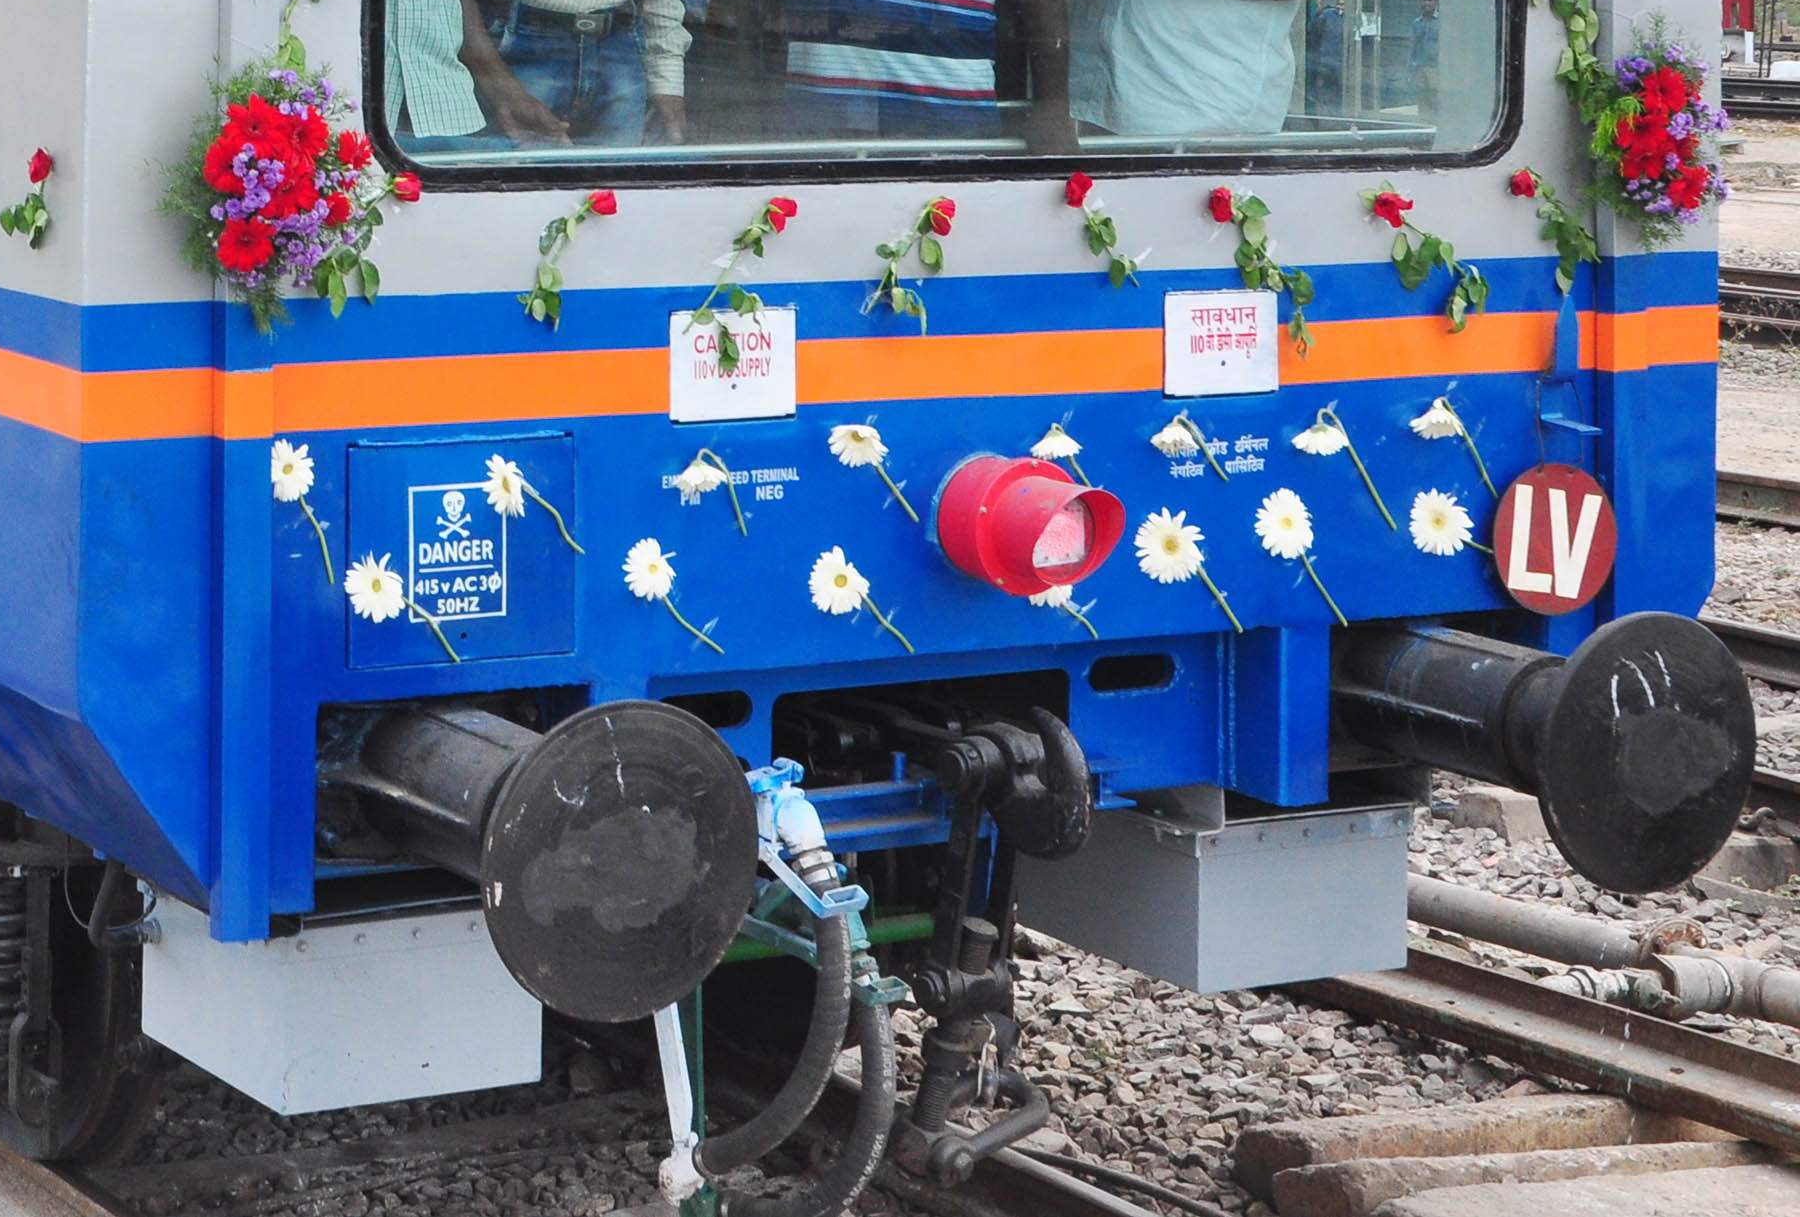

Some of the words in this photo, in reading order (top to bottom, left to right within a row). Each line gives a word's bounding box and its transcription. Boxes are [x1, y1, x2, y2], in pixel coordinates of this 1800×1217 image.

[1190, 306, 1258, 327] सावधान
[694, 331, 772, 354] CATION
[1190, 335, 1205, 354] 110
[735, 356, 772, 378] SUPPLY
[728, 470, 750, 486] EED
[750, 467, 800, 484] TERMINAL
[755, 485, 785, 502] NEG
[418, 538, 494, 565] DANGER
[1507, 483, 1603, 600] LV
[436, 596, 481, 615] 50HZ
